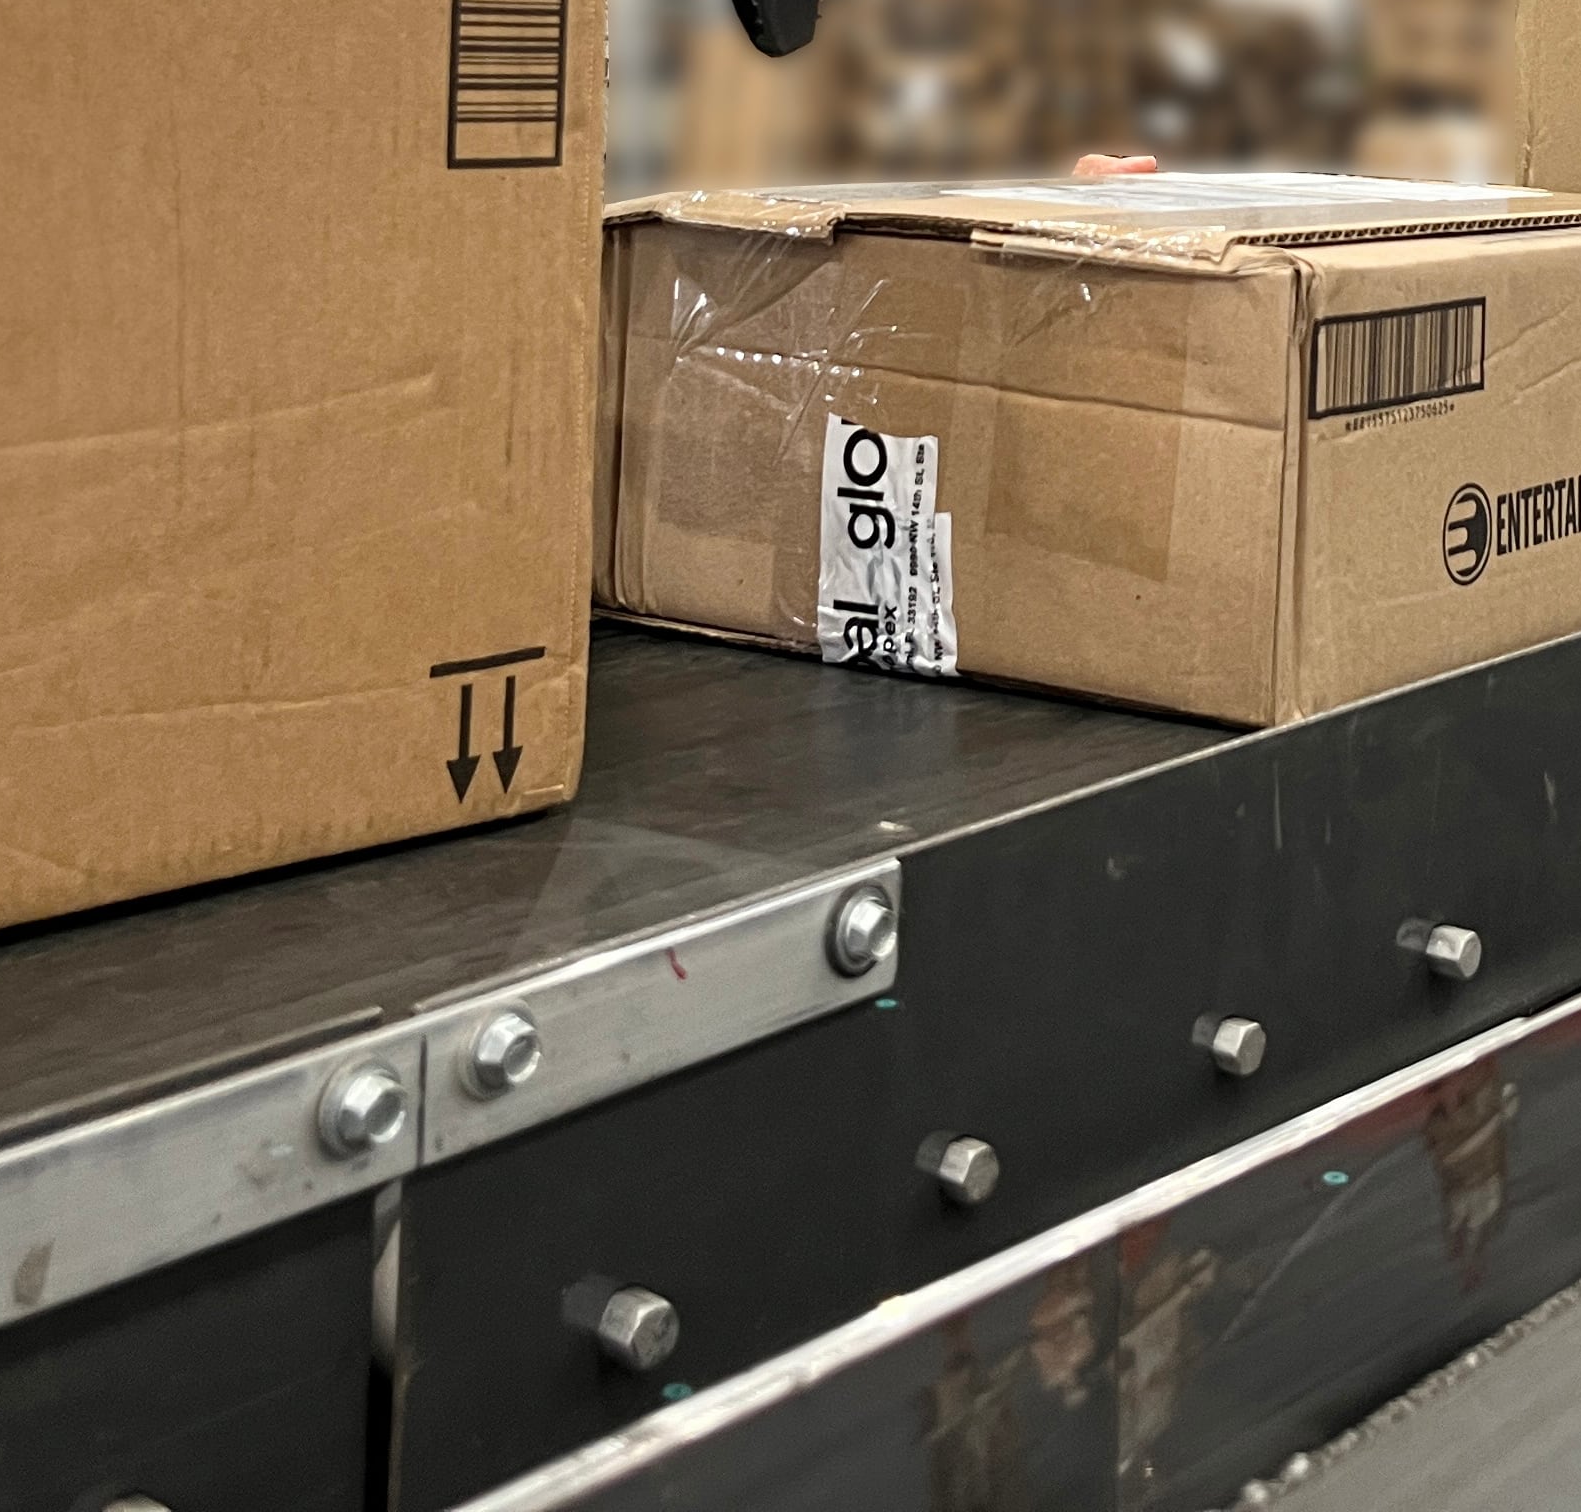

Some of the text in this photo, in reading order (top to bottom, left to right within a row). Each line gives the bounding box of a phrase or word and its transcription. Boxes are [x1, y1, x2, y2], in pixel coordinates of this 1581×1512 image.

[837, 417, 896, 550] glo
[911, 489, 922, 516] 14th
[908, 519, 919, 544] NW
